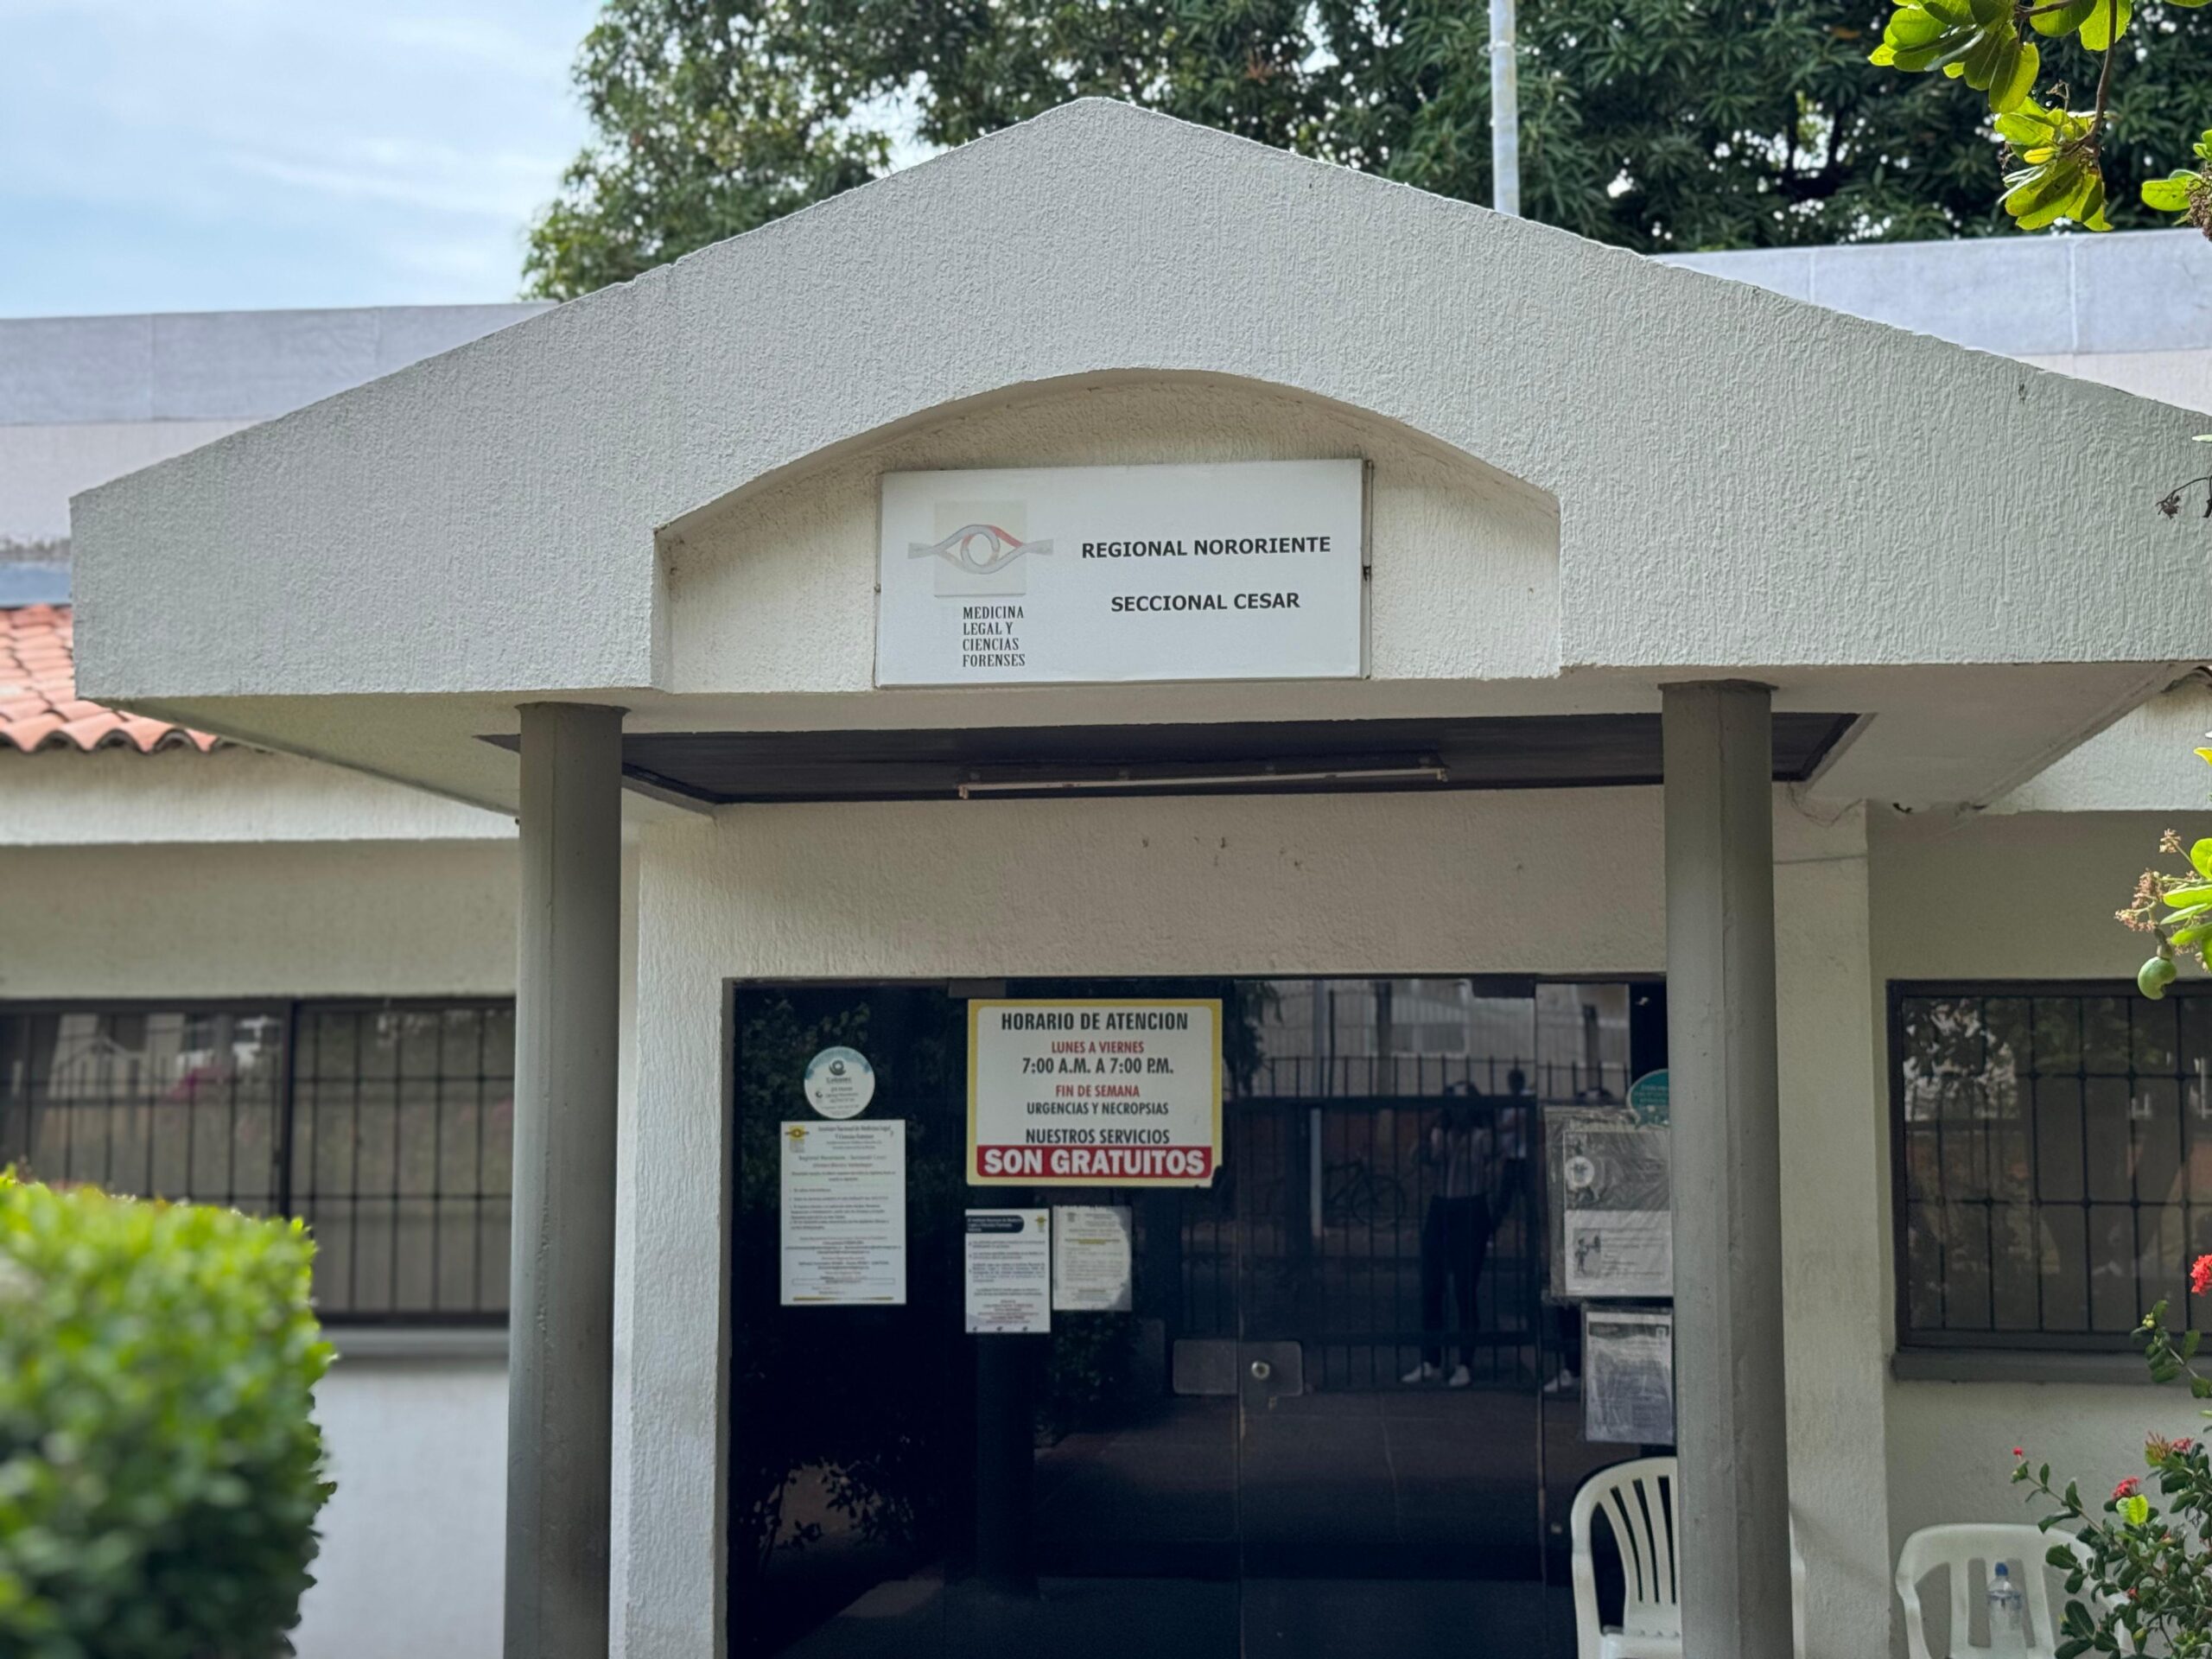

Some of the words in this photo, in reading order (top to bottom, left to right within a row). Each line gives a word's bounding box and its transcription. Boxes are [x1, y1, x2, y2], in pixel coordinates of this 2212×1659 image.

[1082, 538, 1188, 559] REGIONAL
[1194, 536, 1332, 556] NORORIENTE
[1111, 594, 1228, 613] SECCIONAL
[1234, 592, 1300, 610] CESAR
[963, 605, 1024, 620] MEDICINA
[963, 621, 1002, 636] LEGAL
[1005, 621, 1014, 635] Y
[962, 637, 1020, 652] CIENCIAS
[963, 653, 1026, 668] FORENSES
[1001, 1012, 1075, 1031] HORARIO
[1080, 1012, 1100, 1031] DE
[1105, 1012, 1188, 1031] ATENCION
[1051, 1040, 1085, 1054] LUNES
[1089, 1040, 1096, 1054] A
[1099, 1040, 1145, 1054] VIERNES
[1022, 1057, 1055, 1074] 7:00
[1058, 1057, 1091, 1074] A.M.
[1095, 1057, 1106, 1074] A
[1109, 1057, 1142, 1074] 7:00
[1147, 1057, 1174, 1074] P.M.
[1055, 1084, 1074, 1097] FIN
[1077, 1084, 1091, 1097] DE
[1094, 1084, 1141, 1097] SEMANA
[1027, 1102, 1090, 1115] URGENCIAS
[1091, 1102, 1099, 1115] Y
[1101, 1102, 1169, 1115] NECROPSIAS
[1026, 1128, 1096, 1144] NUESTROS
[1099, 1128, 1170, 1144] SERVICIOS
[984, 1148, 1043, 1174] SON
[1050, 1148, 1205, 1175] GRATUITOS
